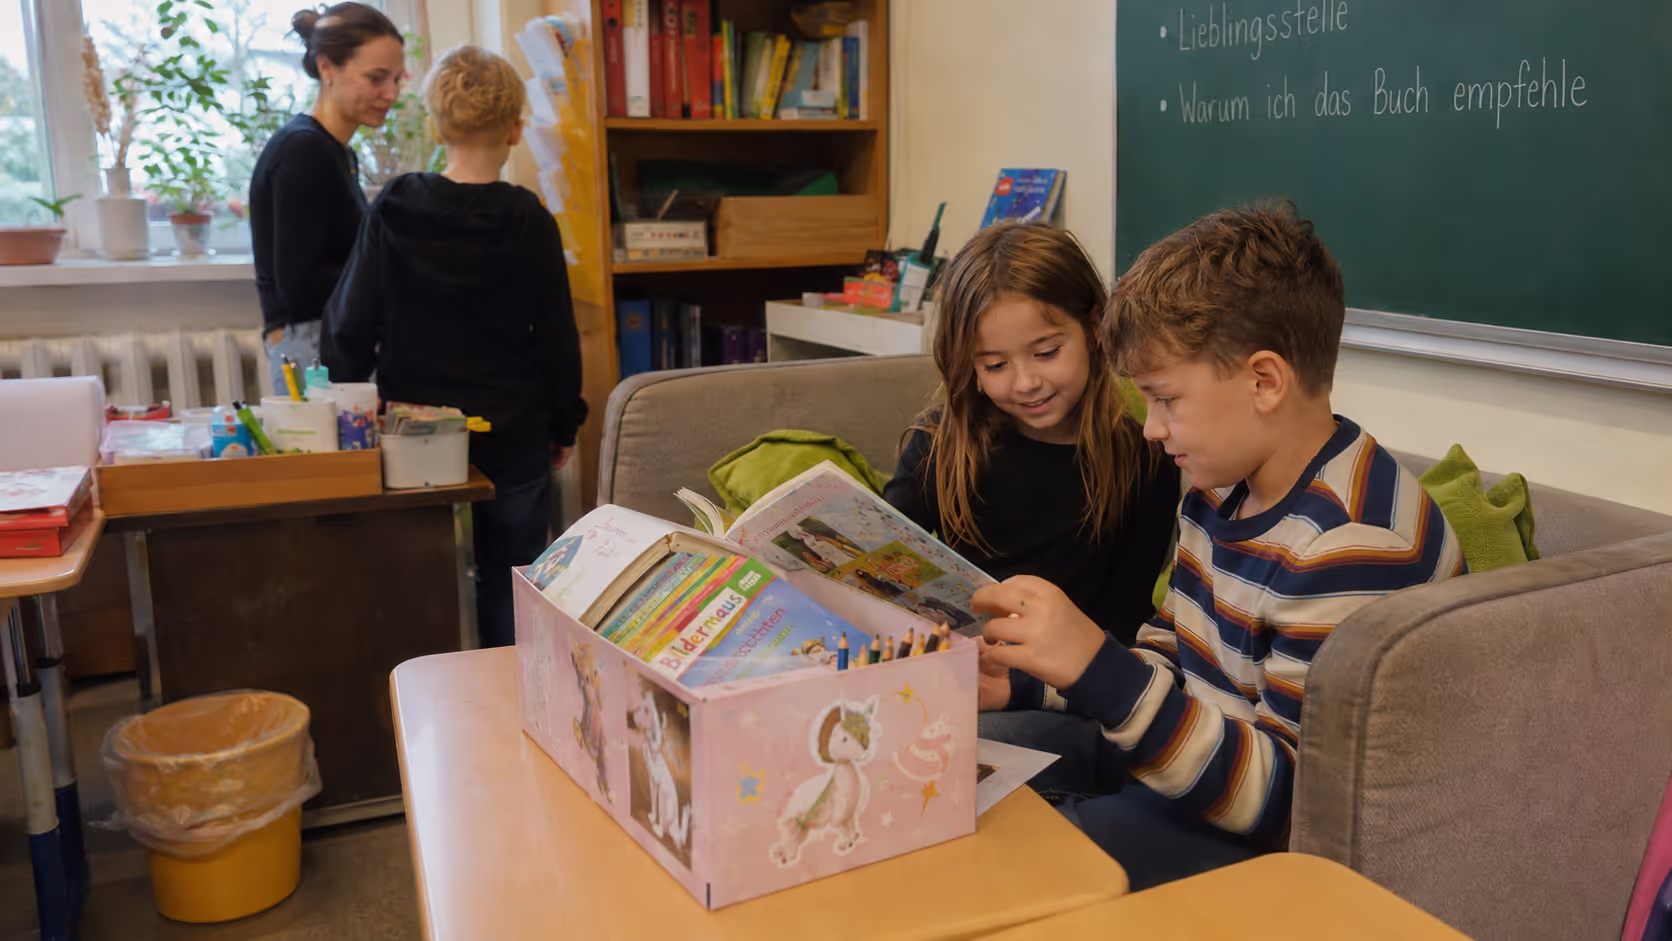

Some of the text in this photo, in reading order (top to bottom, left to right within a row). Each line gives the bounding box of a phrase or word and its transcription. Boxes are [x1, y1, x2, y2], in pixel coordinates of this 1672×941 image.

[1179, 0, 1349, 60] Lieblingsstelle
[1178, 56, 1588, 130] Warum ich das Buch empfehle
[659, 594, 743, 670] Bildermaus
